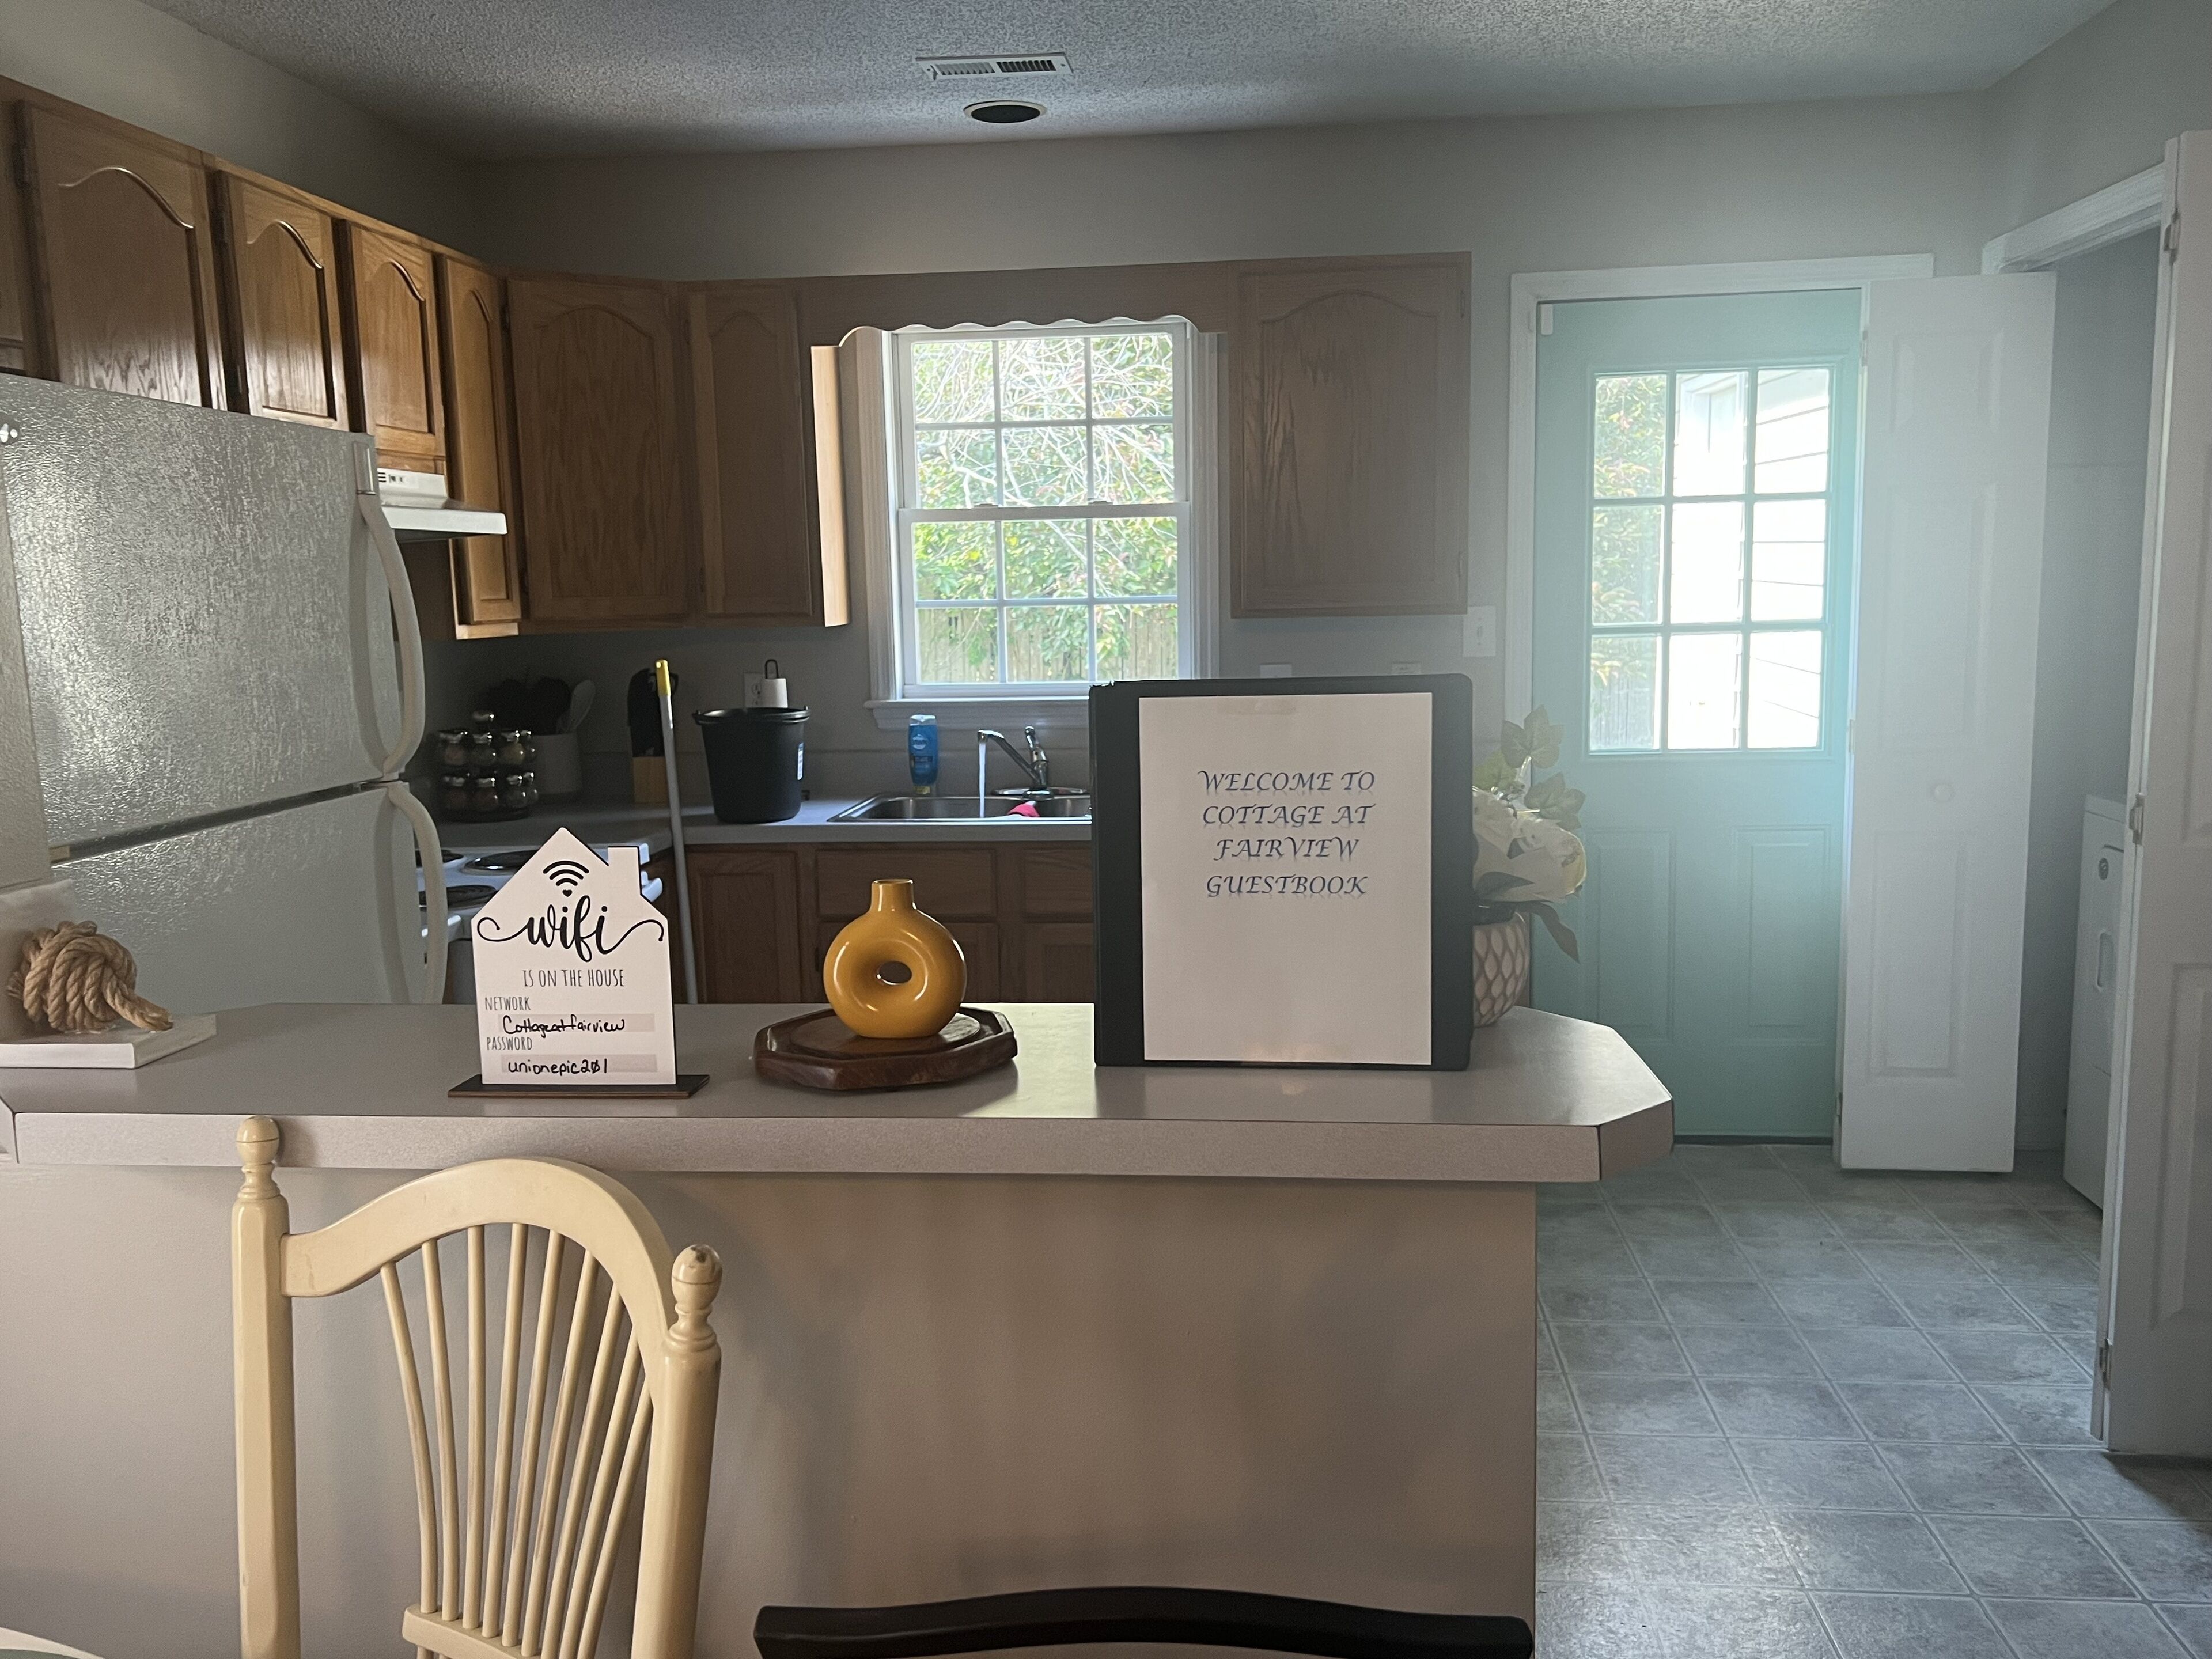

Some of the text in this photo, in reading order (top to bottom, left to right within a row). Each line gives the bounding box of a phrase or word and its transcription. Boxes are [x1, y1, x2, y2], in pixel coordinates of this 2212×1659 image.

[1198, 770, 1375, 791] WELCOME TO
[1203, 803, 1377, 828] COTTAGE AT
[1213, 836, 1360, 861] FAIRVIEW
[1206, 874, 1368, 897] GUESTBOOK
[477, 895, 665, 963] wifi
[522, 969, 625, 987] IS ON THE HOUSE
[484, 997, 531, 1010] NETWORK
[486, 1036, 532, 1051] PASSWORD
